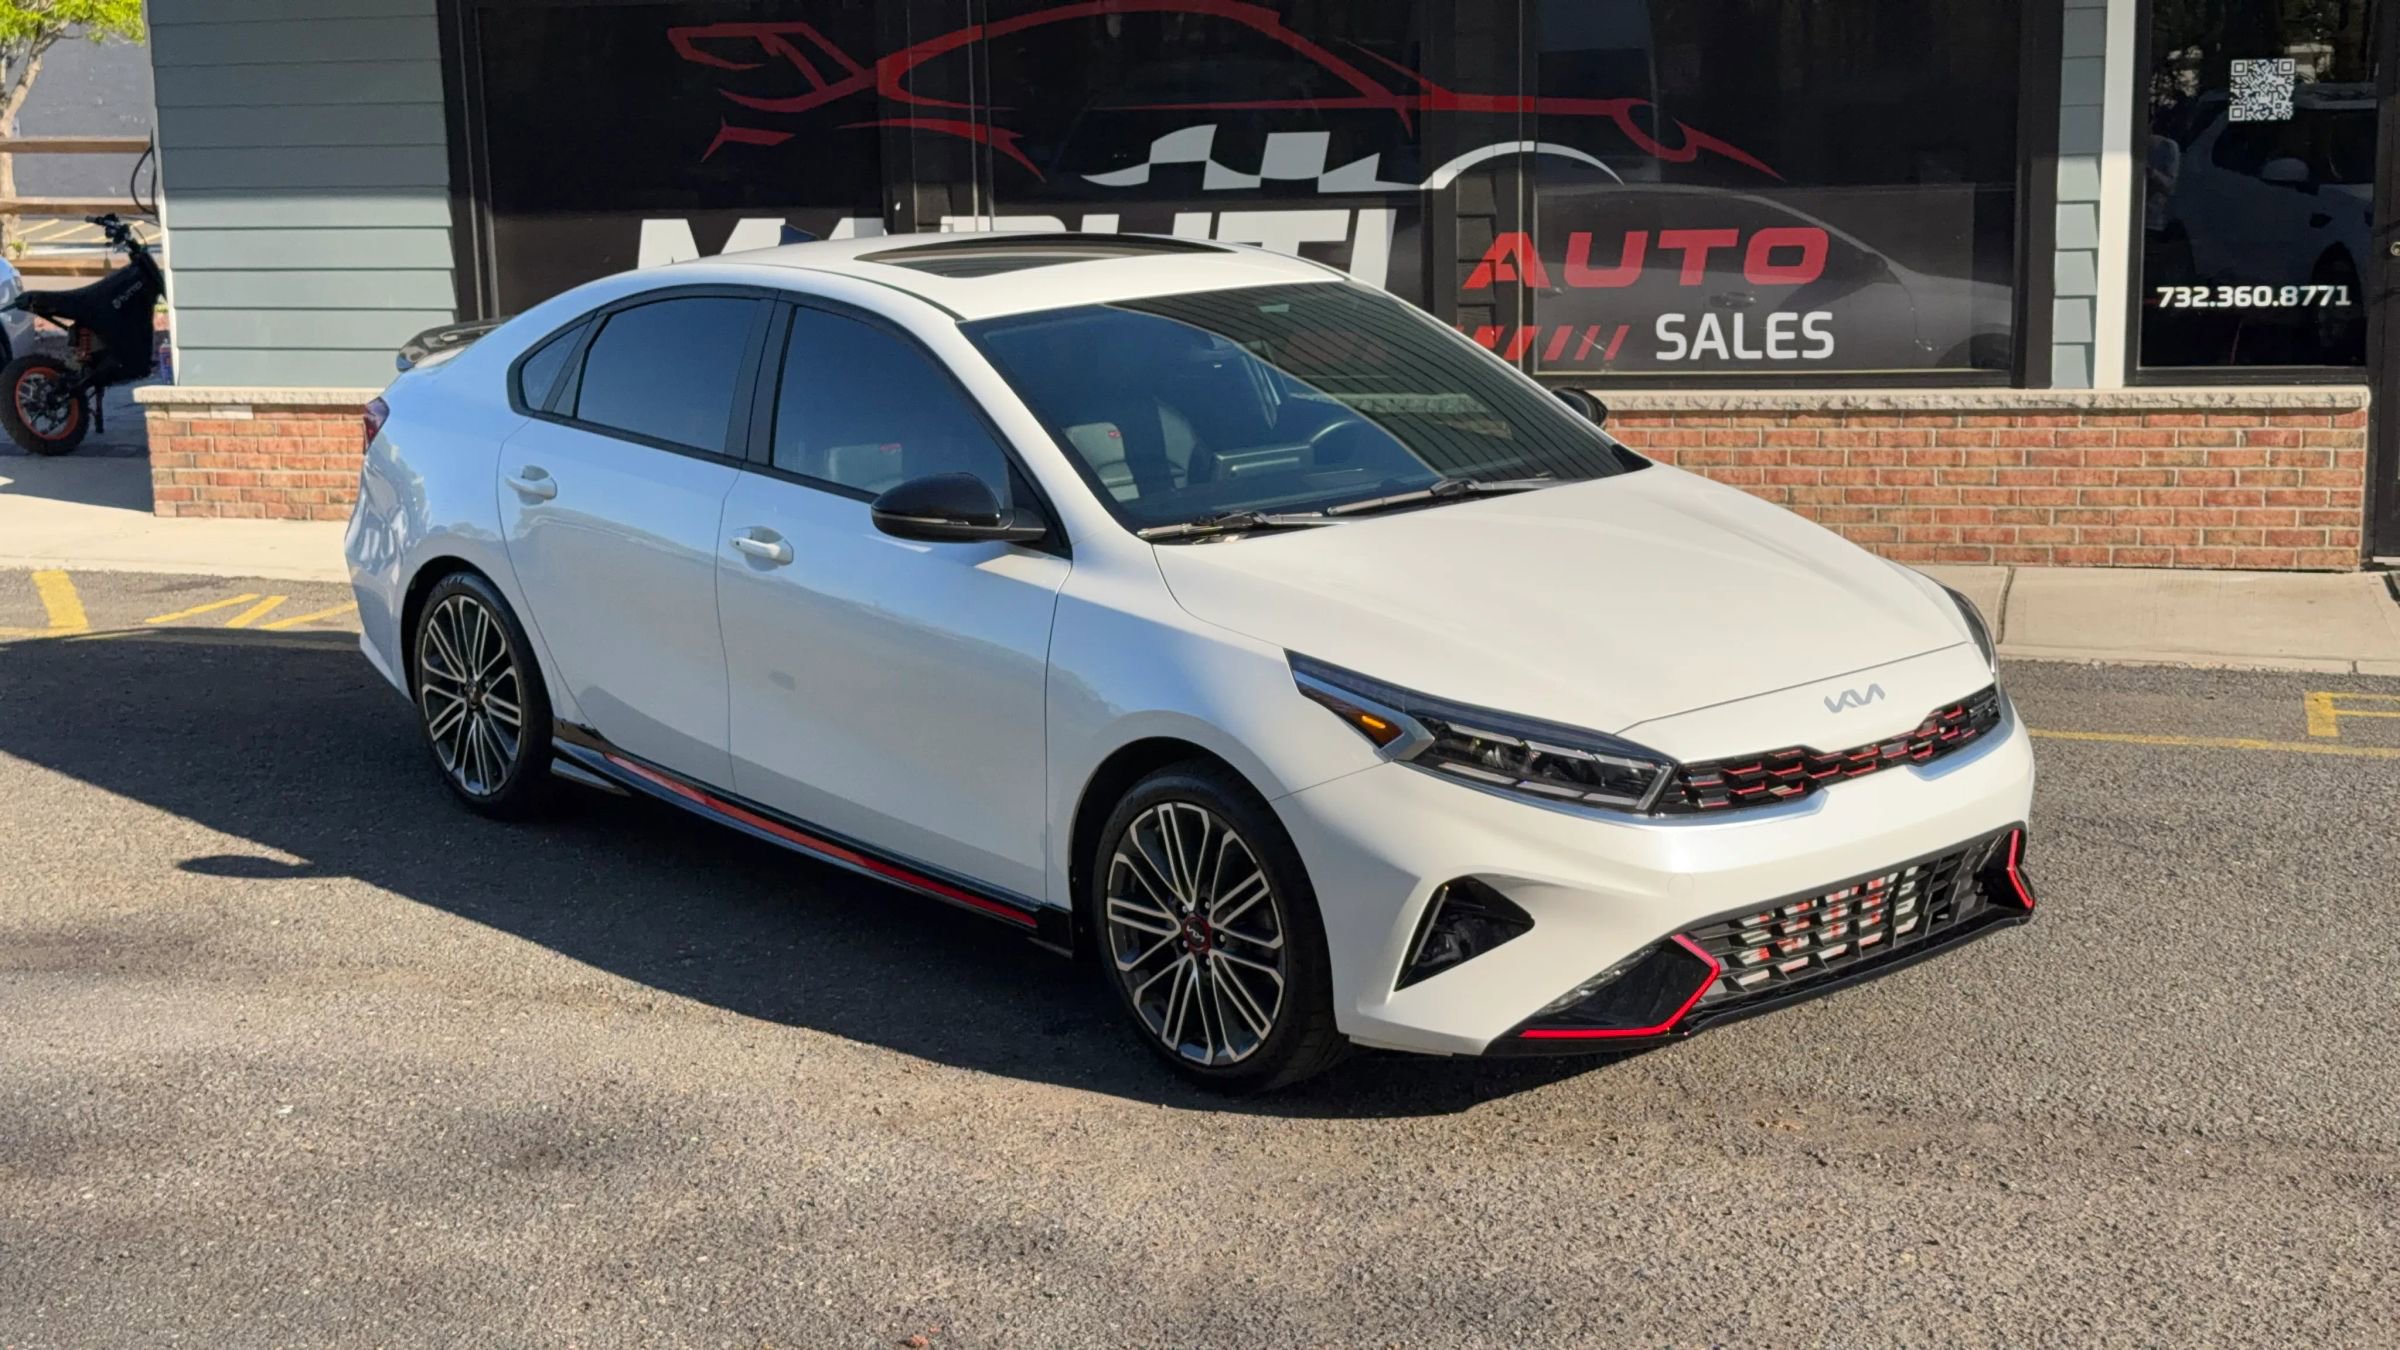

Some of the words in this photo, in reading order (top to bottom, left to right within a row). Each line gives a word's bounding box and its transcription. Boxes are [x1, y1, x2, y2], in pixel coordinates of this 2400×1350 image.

[1462, 227, 1829, 289] AUTO
[2156, 285, 2352, 308] 732.360.8771
[1655, 311, 1834, 361] SALES
[1824, 683, 1886, 713] KIA
